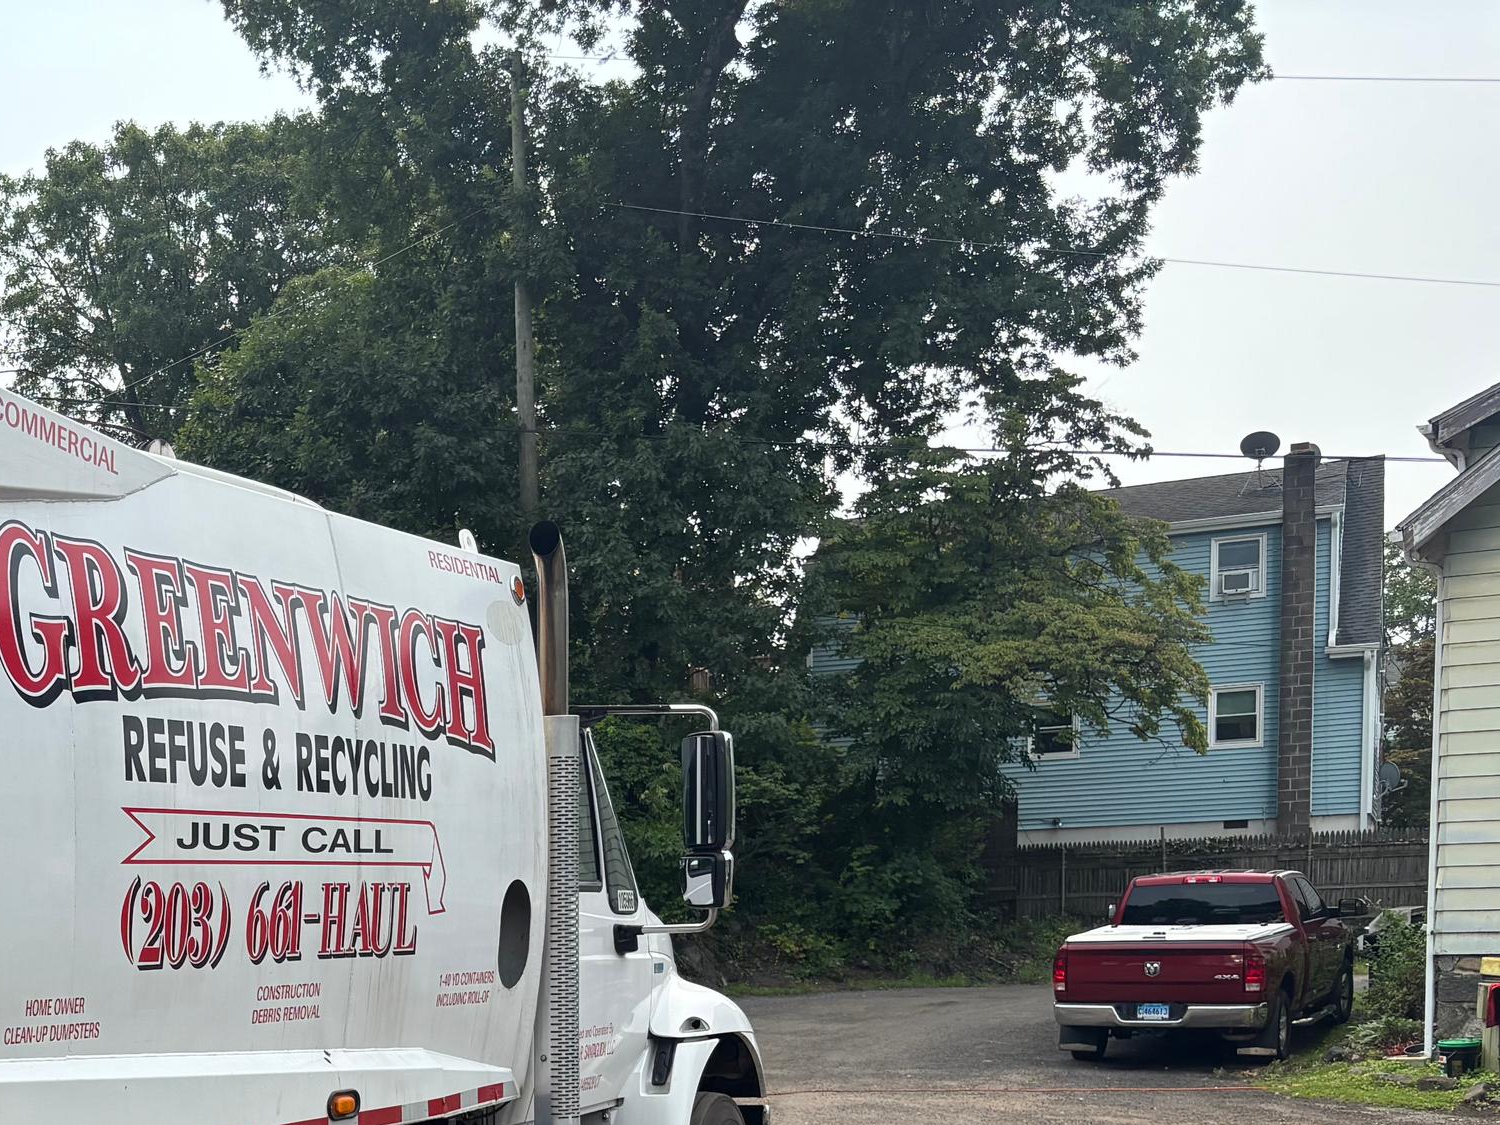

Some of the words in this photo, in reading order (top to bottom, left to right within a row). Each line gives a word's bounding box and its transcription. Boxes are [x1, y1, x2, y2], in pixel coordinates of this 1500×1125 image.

[428, 550, 503, 584] RESIDENTIAL
[123, 715, 246, 788] REFUSE
[262, 728, 282, 790] &
[296, 732, 432, 802] RECYCLING
[176, 822, 285, 851] JUST
[301, 827, 394, 853] CALL
[120, 874, 232, 970] (203)
[245, 880, 417, 967] 661-HAUL
[452, 973, 460, 986] YD
[461, 971, 494, 985] CONTAINERS
[257, 983, 321, 1001] CONSTRUCTION
[436, 992, 467, 1007] INCLUDING
[26, 999, 52, 1016] HOME
[54, 998, 85, 1015] OWNER
[252, 1008, 281, 1024] DEBRIS
[283, 1005, 320, 1021] REMOVAL
[4, 1026, 48, 1045] CLEAN-UP
[50, 1022, 100, 1041] DUMPSTERS
